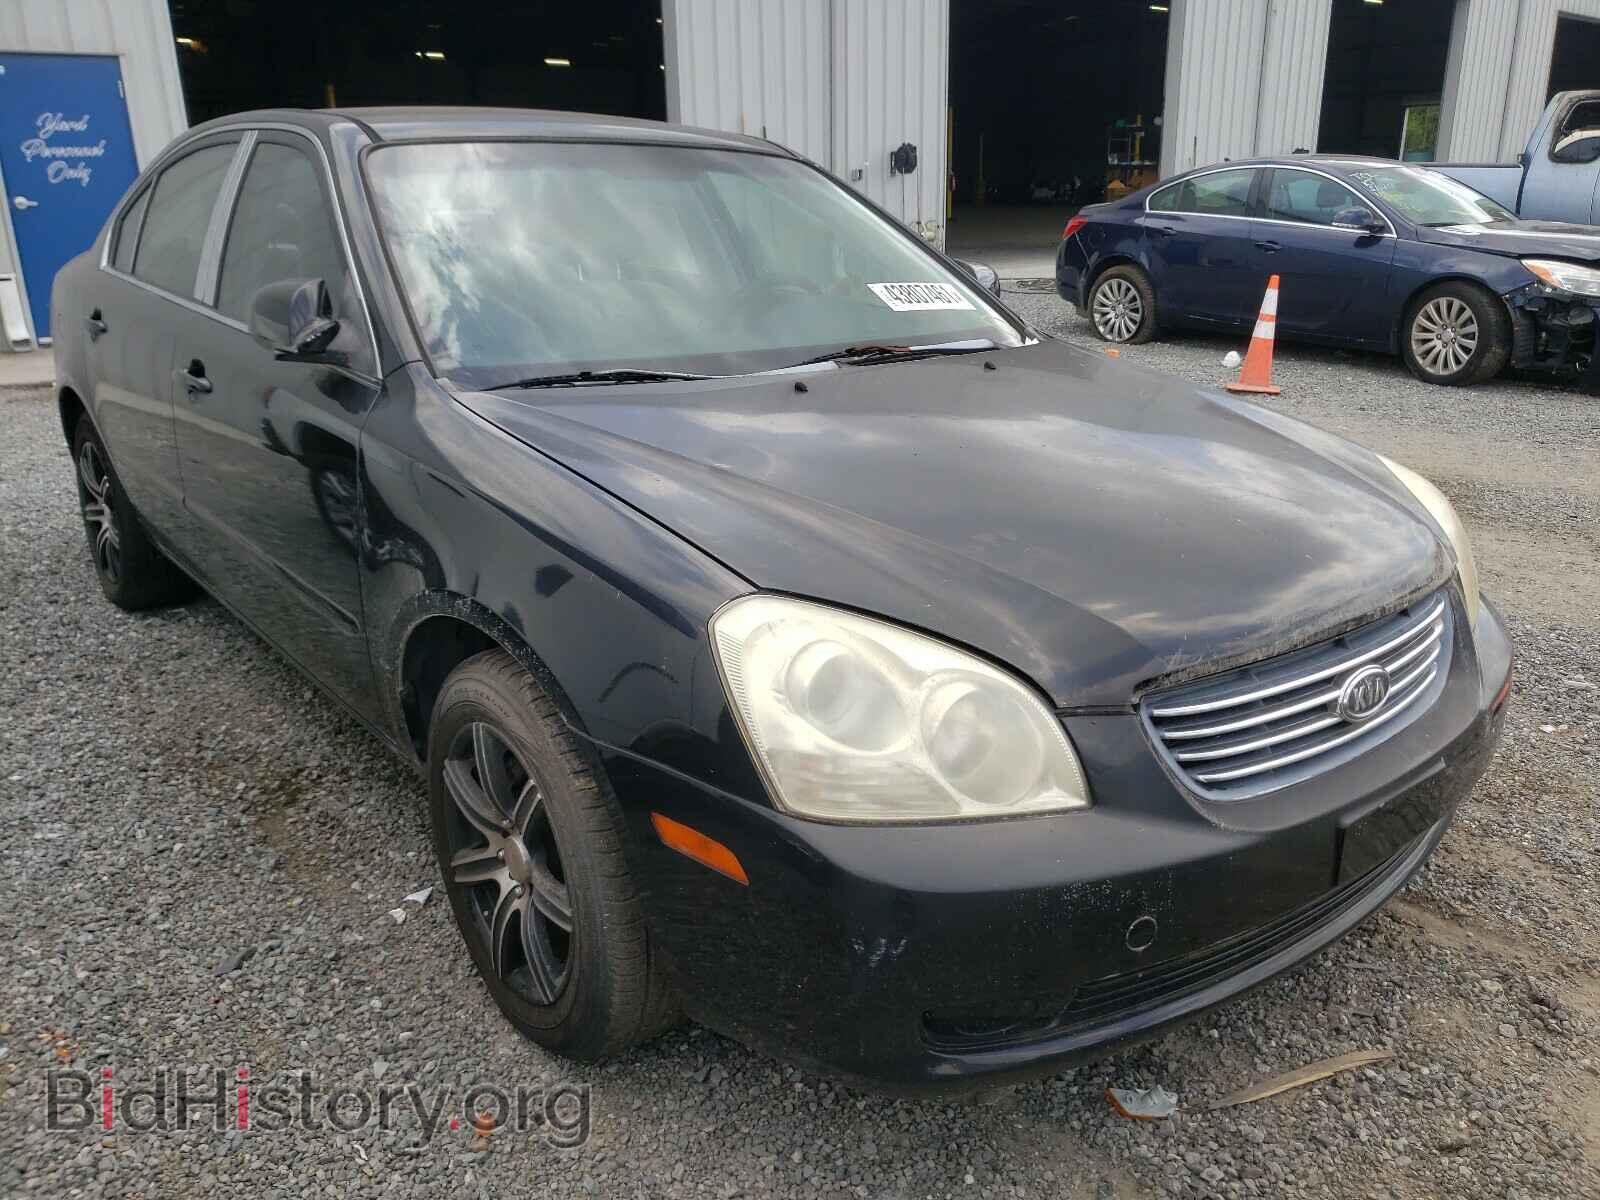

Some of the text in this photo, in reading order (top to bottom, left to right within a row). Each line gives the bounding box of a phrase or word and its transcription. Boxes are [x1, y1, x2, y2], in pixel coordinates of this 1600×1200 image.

[36, 112, 90, 139] Yard
[21, 138, 106, 162] Personnel
[47, 160, 92, 187] Only
